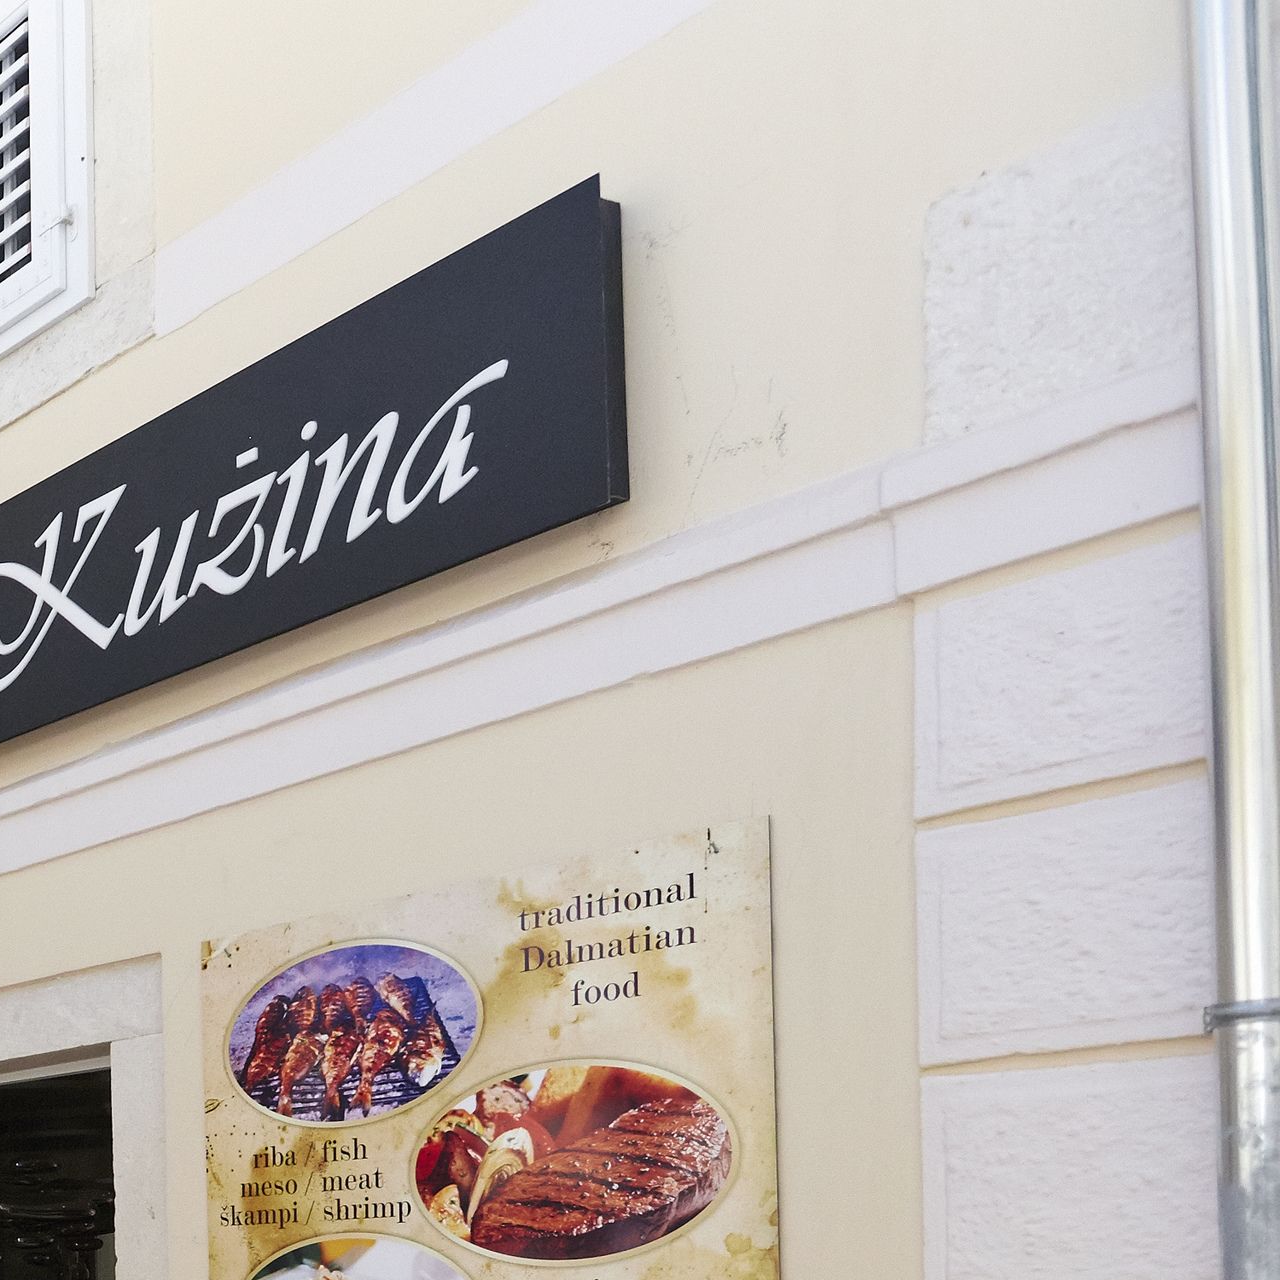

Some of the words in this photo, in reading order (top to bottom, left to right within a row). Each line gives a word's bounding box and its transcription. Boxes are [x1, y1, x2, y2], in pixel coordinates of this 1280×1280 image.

[518, 872, 698, 933] traditional
[519, 922, 698, 975] Dalmatian
[570, 972, 641, 1007] food
[252, 1144, 298, 1170] riba
[321, 1138, 369, 1164] fish
[240, 1175, 298, 1199] meso
[321, 1168, 385, 1194] meat
[219, 1198, 299, 1229] škampi
[323, 1196, 413, 1227] shrimp
